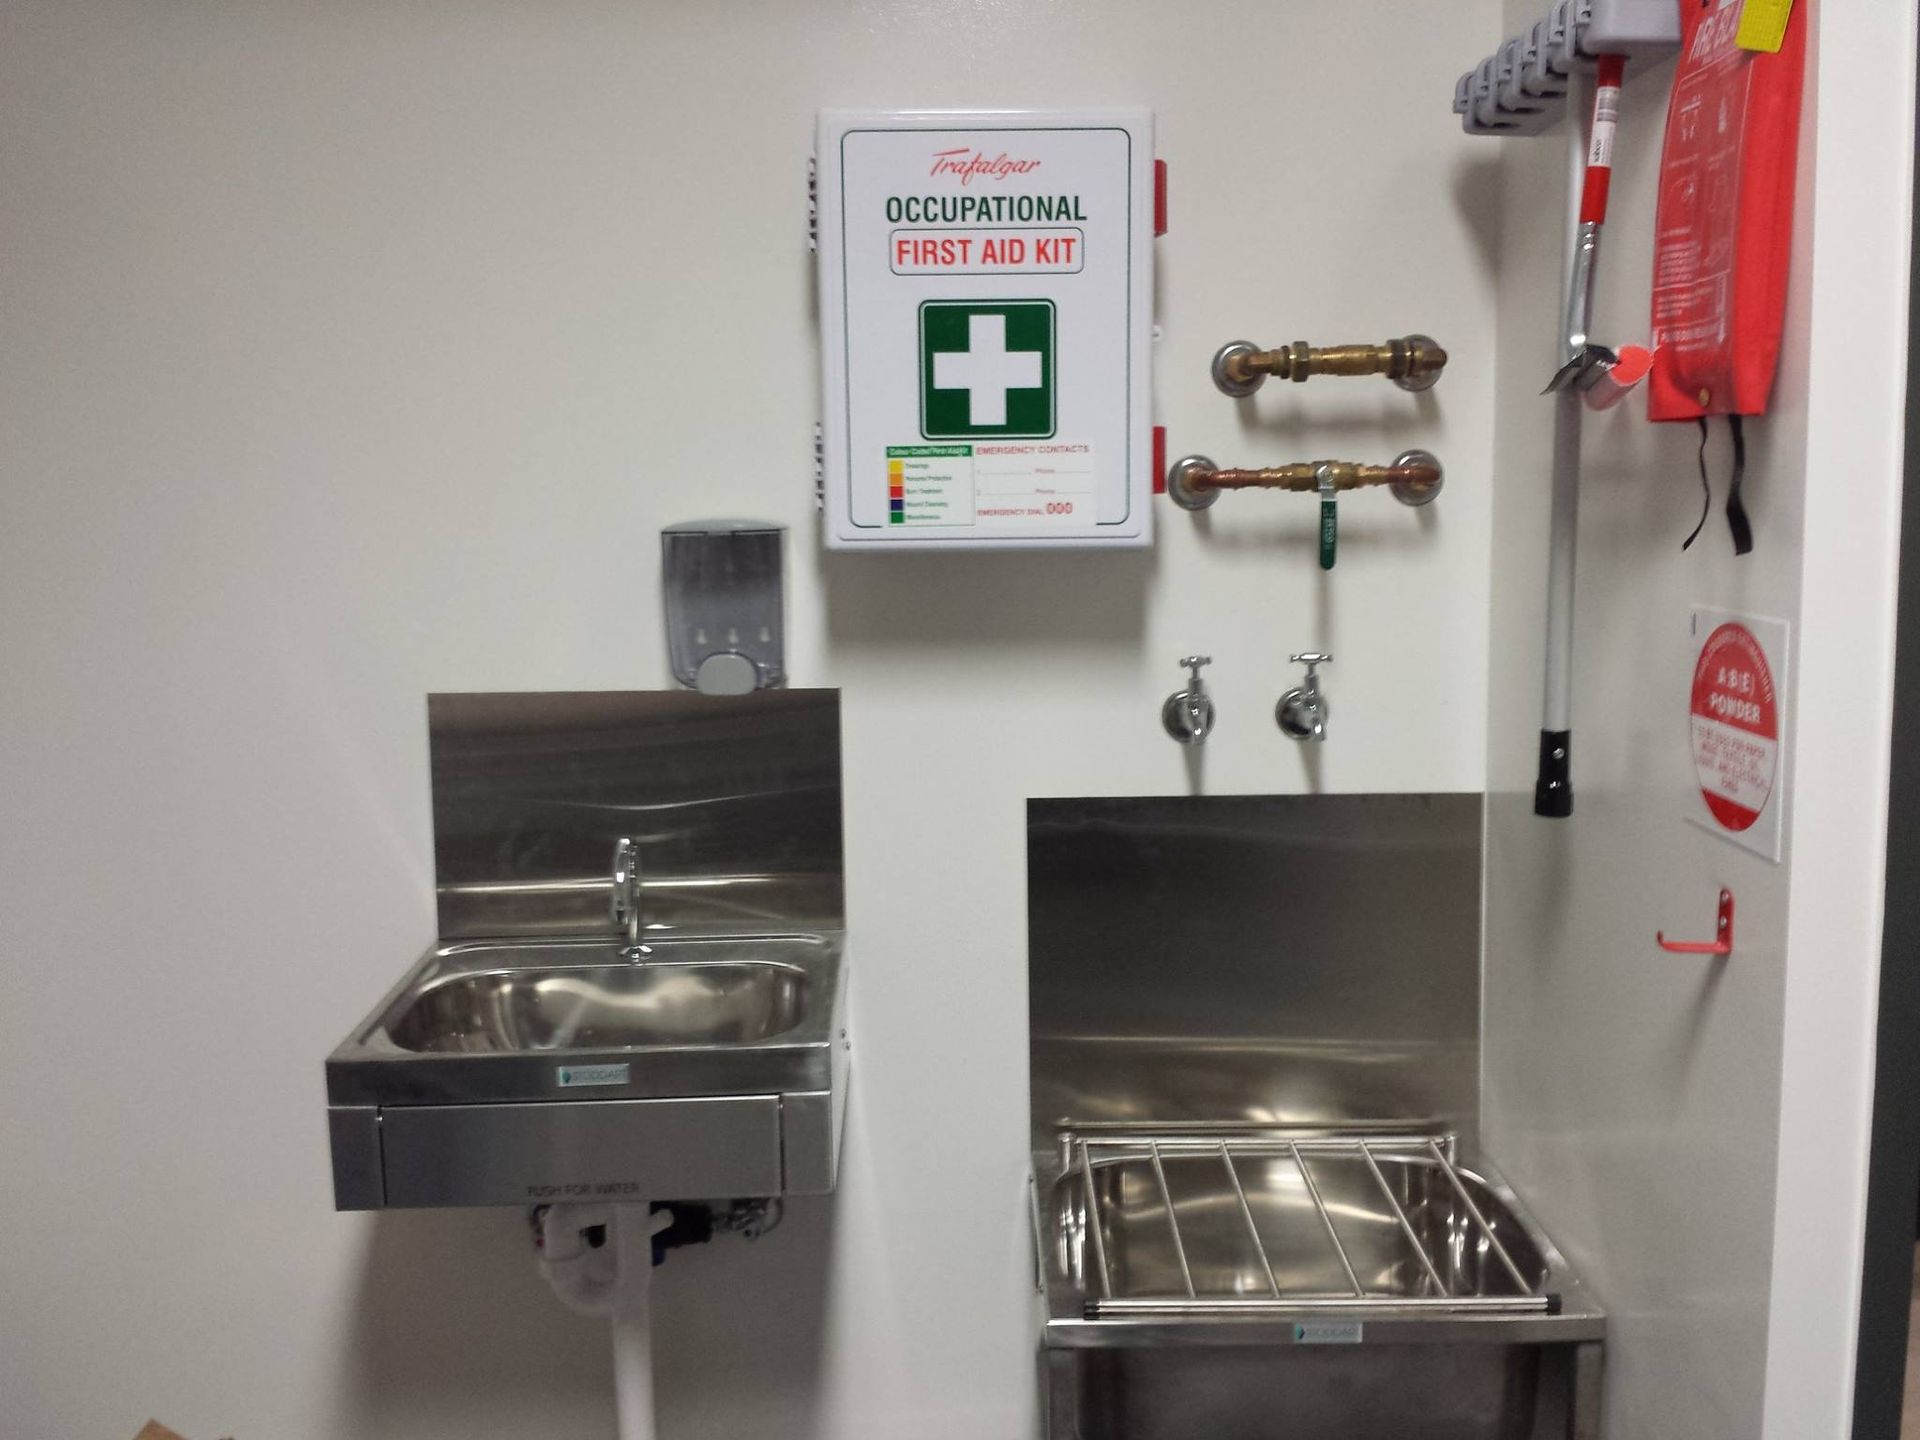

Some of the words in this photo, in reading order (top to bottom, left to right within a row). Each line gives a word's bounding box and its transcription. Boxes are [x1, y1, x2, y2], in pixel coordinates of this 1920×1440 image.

[931, 148, 1041, 186] Trafalgar
[886, 196, 1088, 223] OCCUPATIONAL
[897, 239, 972, 265] FIRST
[982, 239, 1025, 265] AID
[1036, 238, 1077, 264] KIT
[976, 446, 1035, 455] EMERGENCY
[1037, 445, 1090, 454] CONTACTS
[977, 509, 1026, 517] EMERGENCY
[1046, 502, 1074, 515] 000
[1709, 691, 1760, 724] POWDER
[527, 1185, 562, 1197] PUSH
[565, 1184, 591, 1196] FOR
[596, 1182, 640, 1194] WATER
